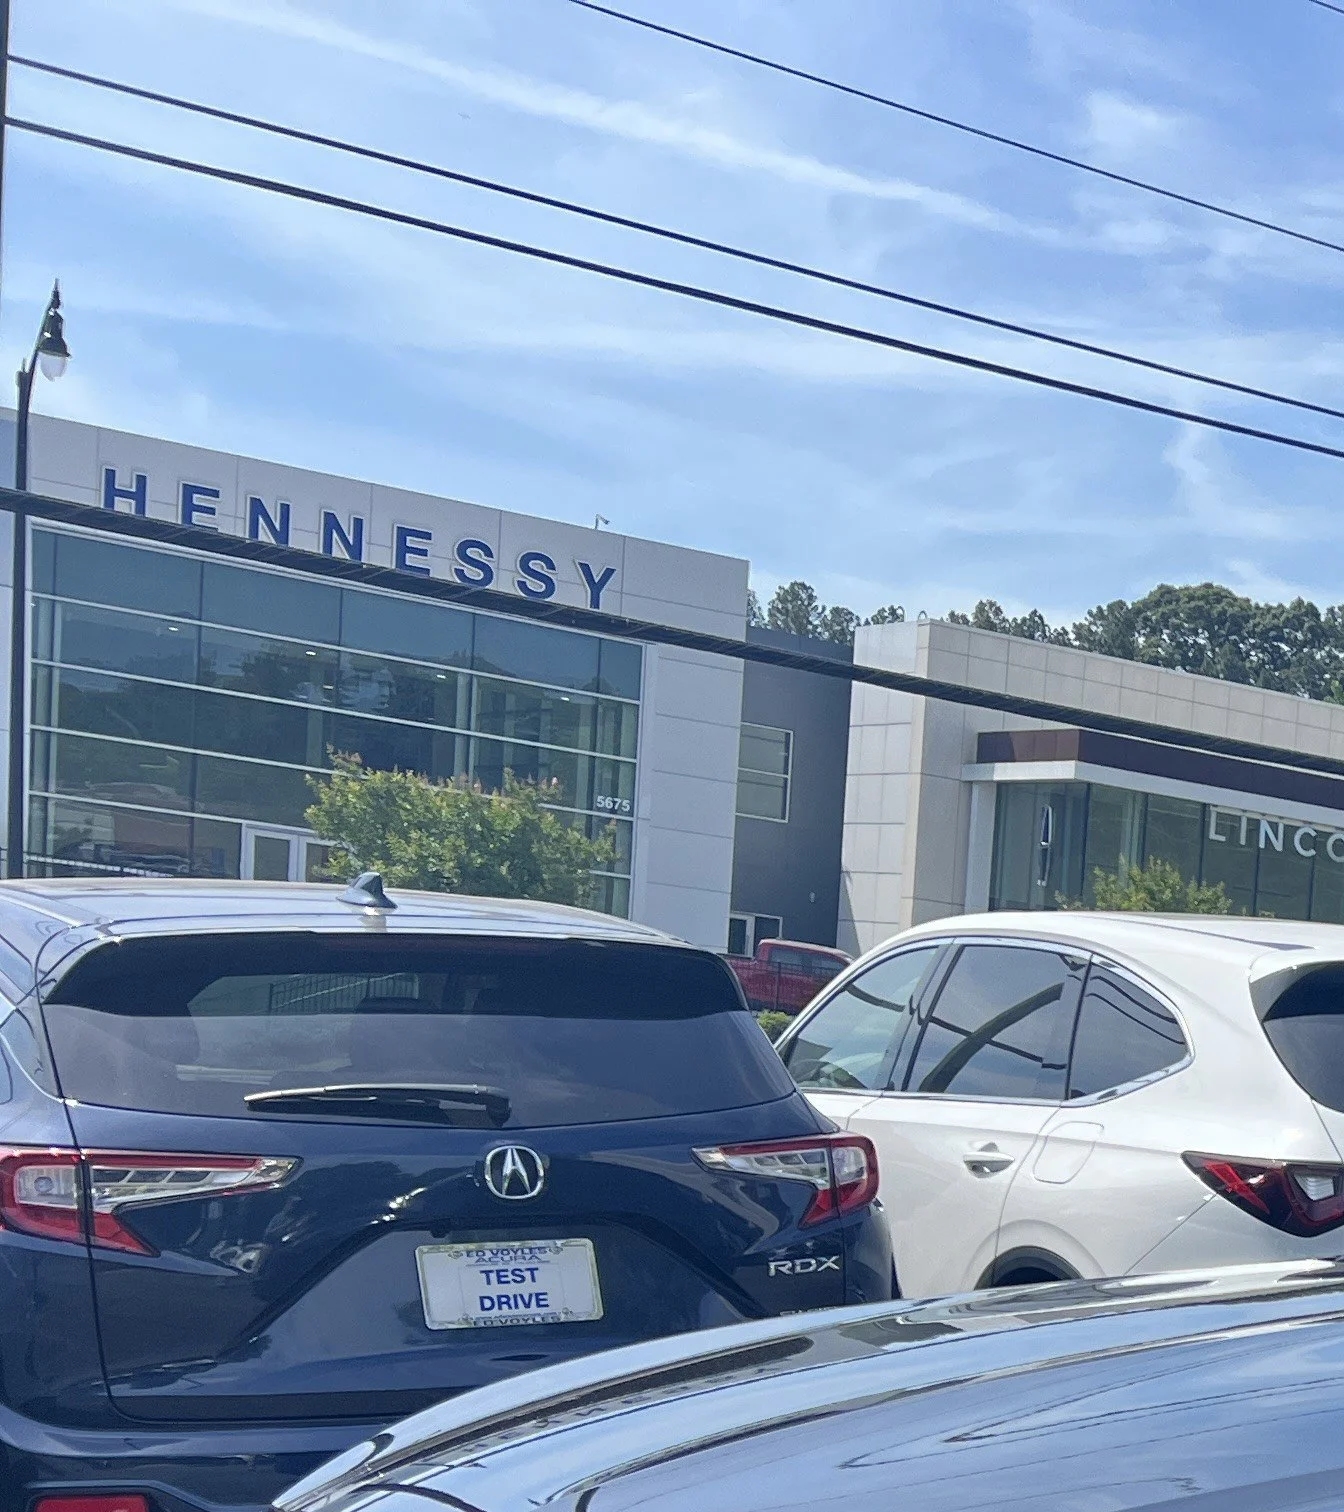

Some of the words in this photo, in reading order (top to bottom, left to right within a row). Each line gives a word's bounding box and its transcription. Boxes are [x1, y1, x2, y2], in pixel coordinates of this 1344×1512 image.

[102, 466, 617, 610] HENNESSY
[596, 795, 631, 812] 5675
[466, 1249, 486, 1258] ED
[490, 1246, 549, 1257] VOYLES
[475, 1254, 543, 1264] ACURA
[767, 1254, 841, 1277] RDX
[479, 1266, 540, 1286] TEST
[479, 1291, 550, 1312] DRIVE
